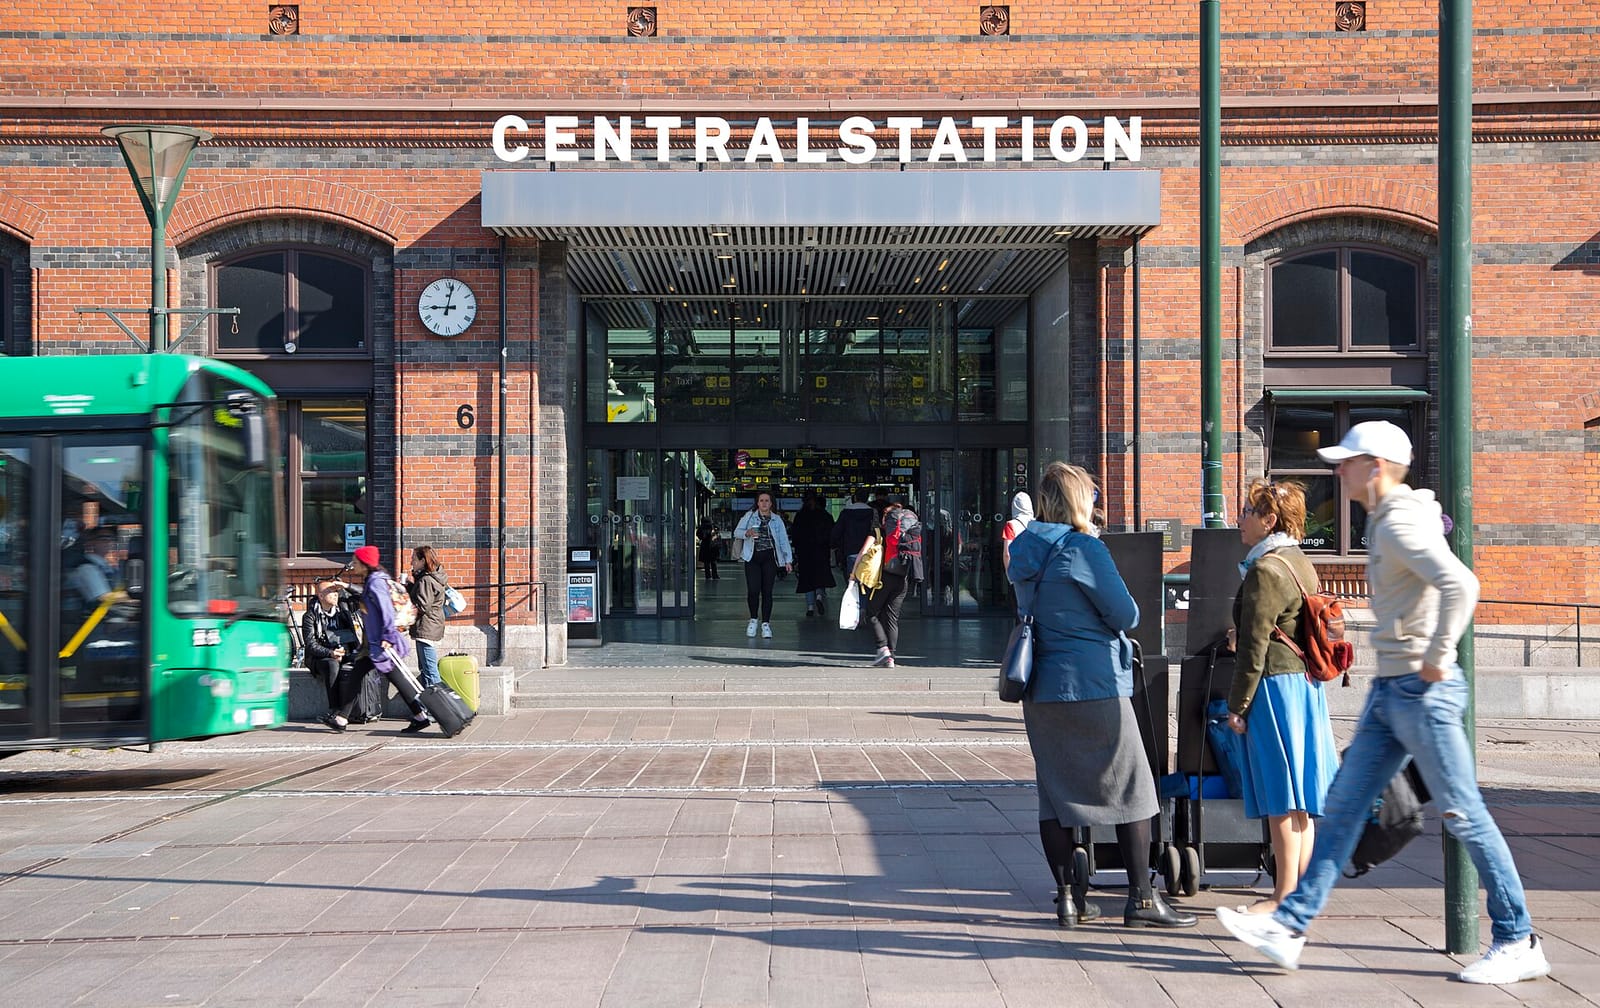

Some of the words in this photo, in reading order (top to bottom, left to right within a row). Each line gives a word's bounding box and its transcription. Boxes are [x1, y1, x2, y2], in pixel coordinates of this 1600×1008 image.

[491, 115, 1142, 164] CENTRALSTATION
[675, 376, 693, 385] Taxi
[457, 404, 475, 429] 6
[1300, 537, 1325, 547] unge
